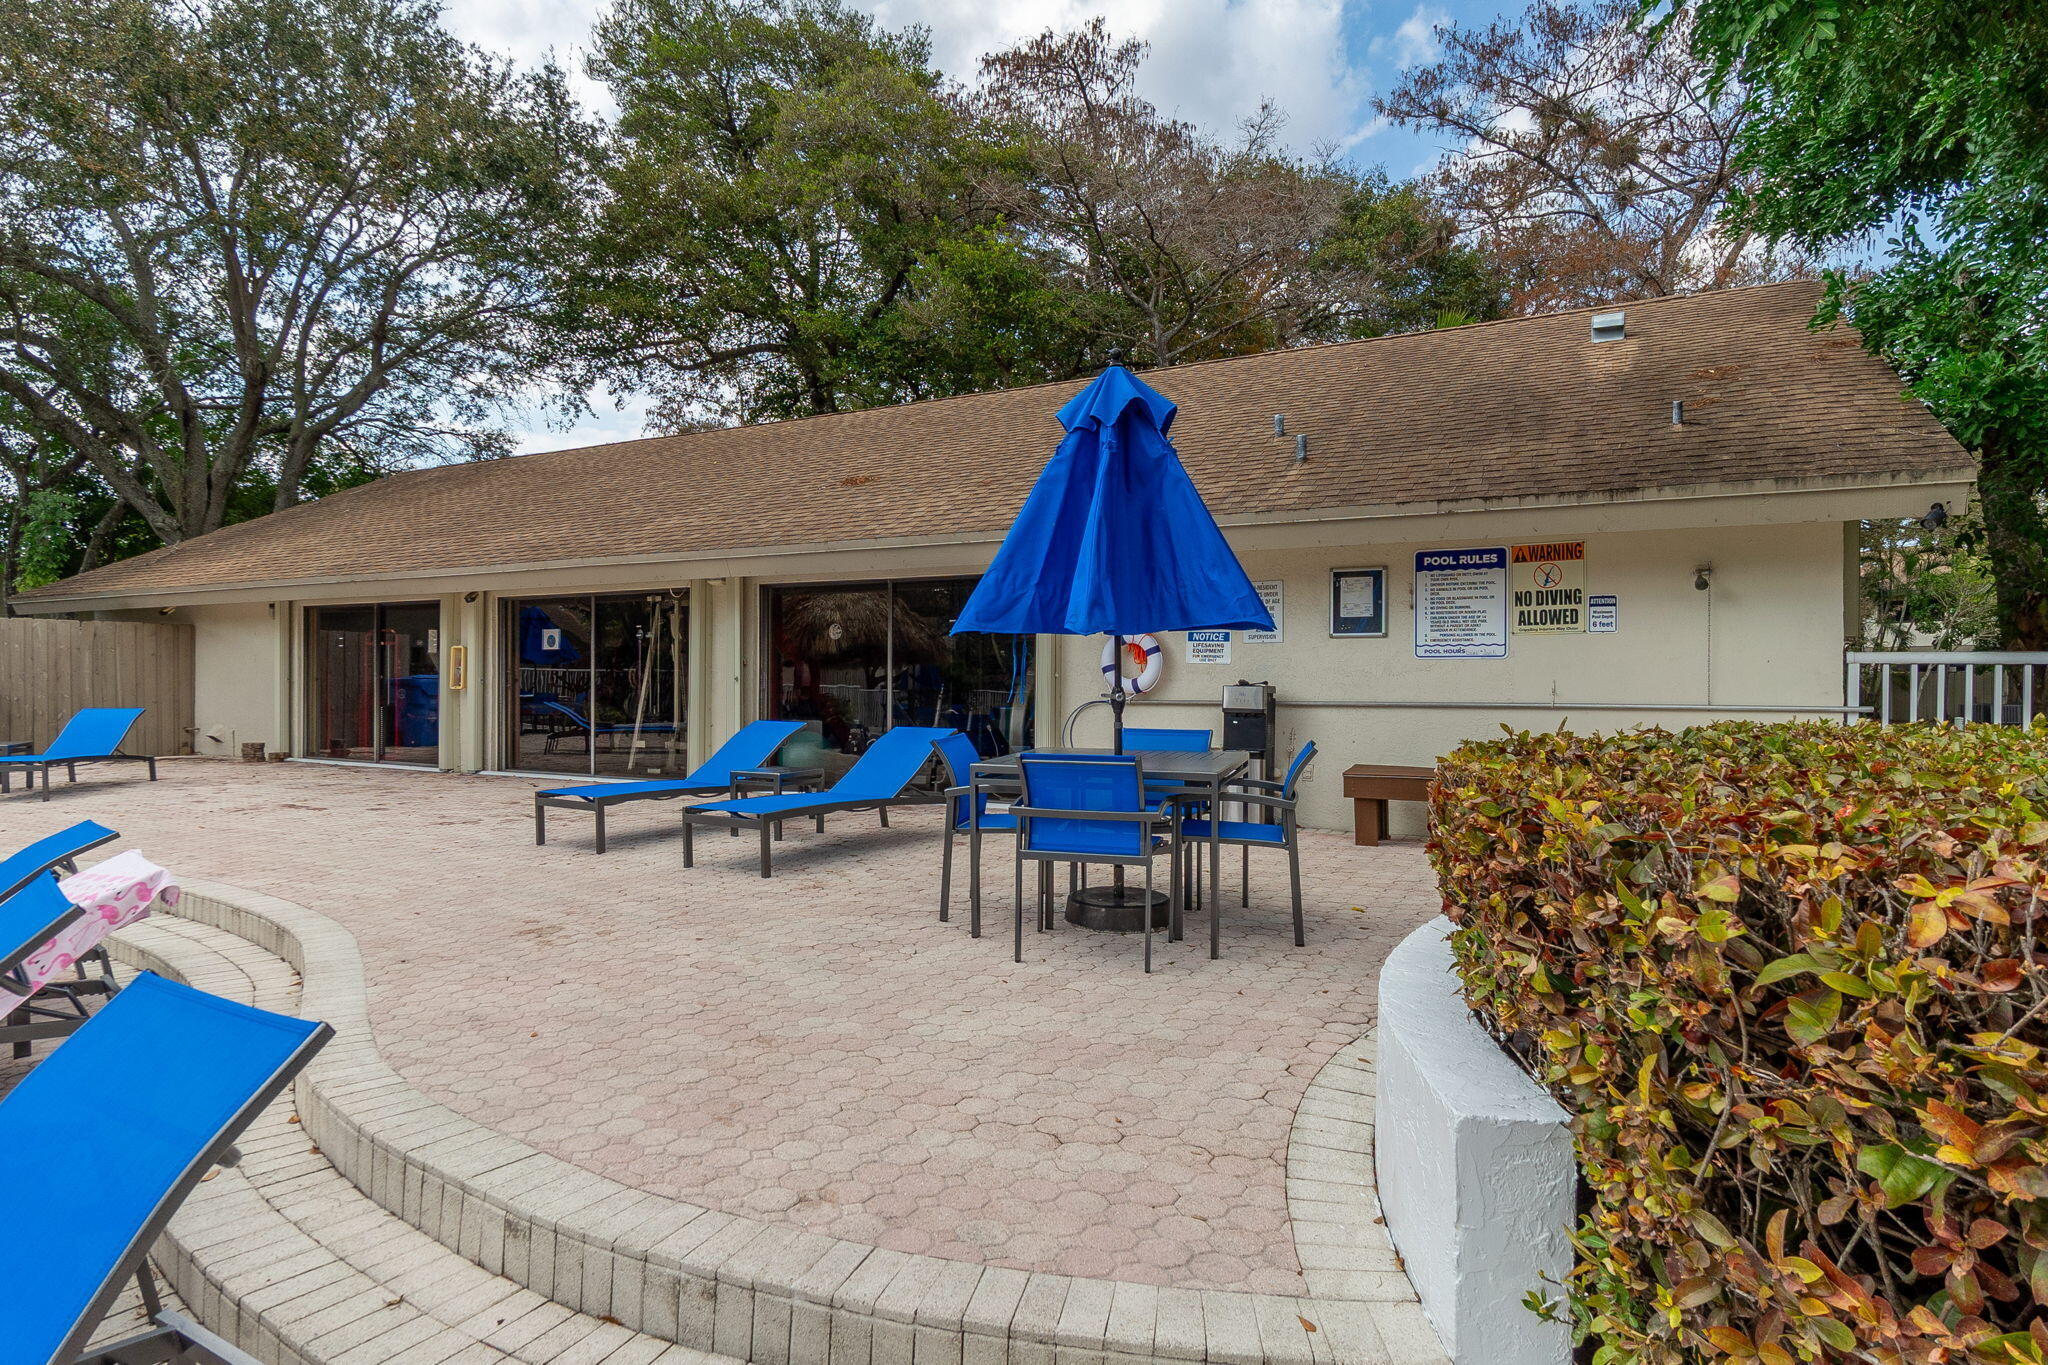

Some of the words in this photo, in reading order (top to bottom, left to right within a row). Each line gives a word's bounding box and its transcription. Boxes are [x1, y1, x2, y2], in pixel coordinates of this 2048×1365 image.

[1424, 556, 1457, 566] POOL
[1459, 554, 1498, 564] RULES
[1528, 542, 1583, 561] WARNING
[1514, 590, 1532, 607] NO
[1536, 588, 1582, 606] DIVING
[1518, 608, 1579, 626] ALLOWED
